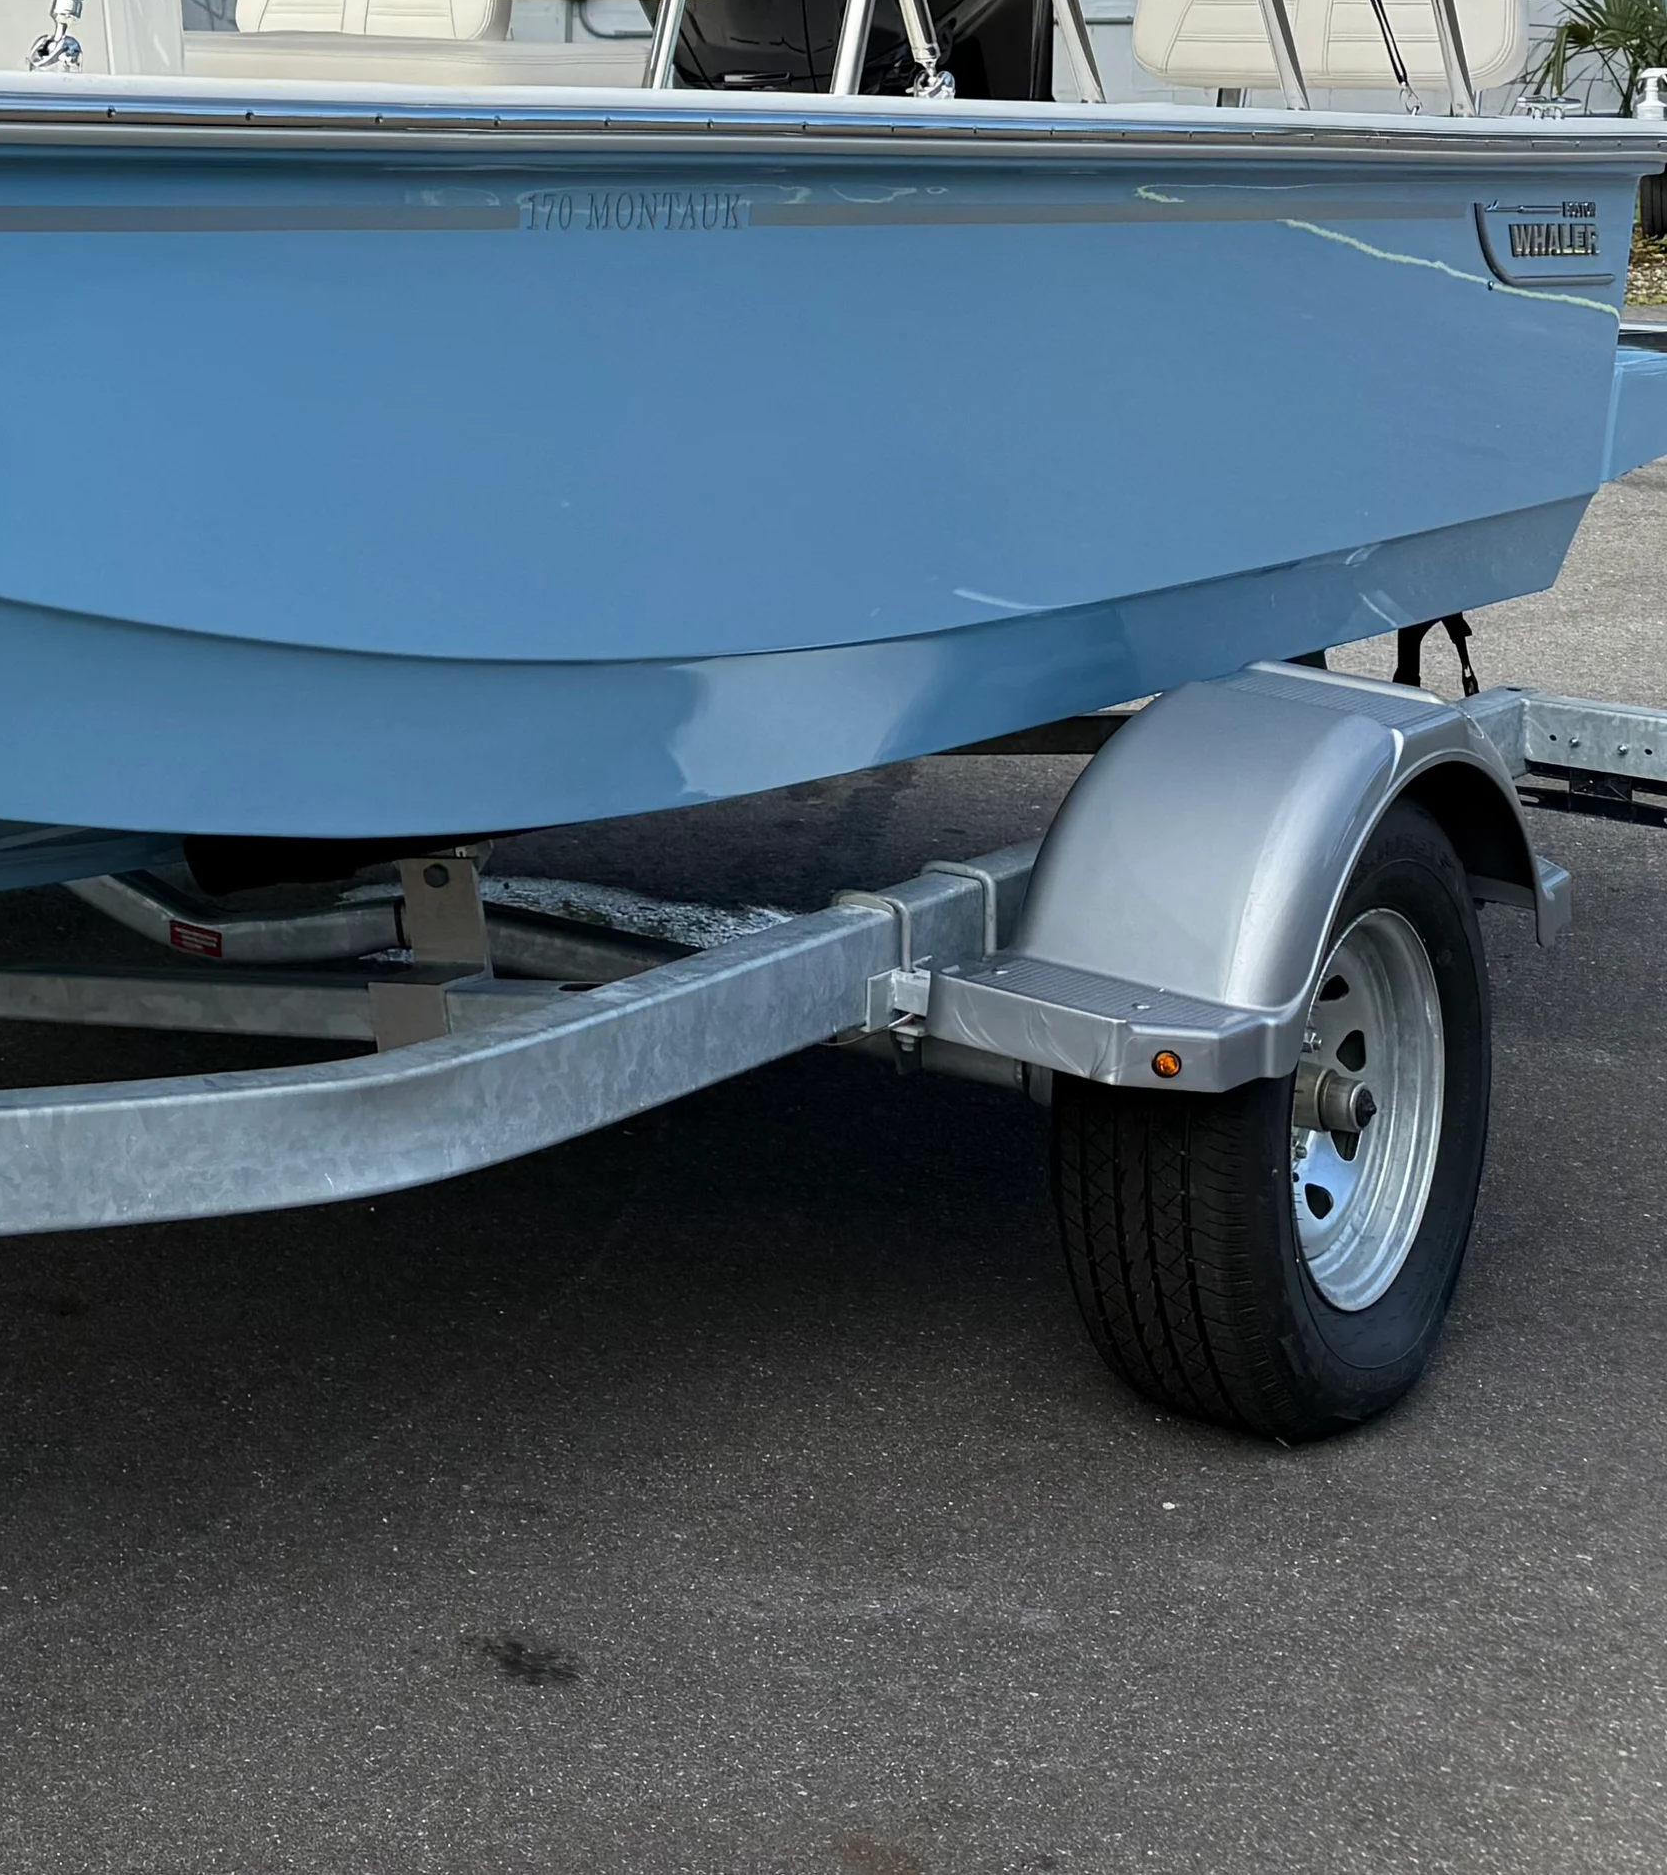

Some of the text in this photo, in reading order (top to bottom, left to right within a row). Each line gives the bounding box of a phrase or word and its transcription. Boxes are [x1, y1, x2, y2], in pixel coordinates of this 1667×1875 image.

[527, 192, 743, 231] 170 MONTAUK
[1509, 223, 1600, 257] WHALER
